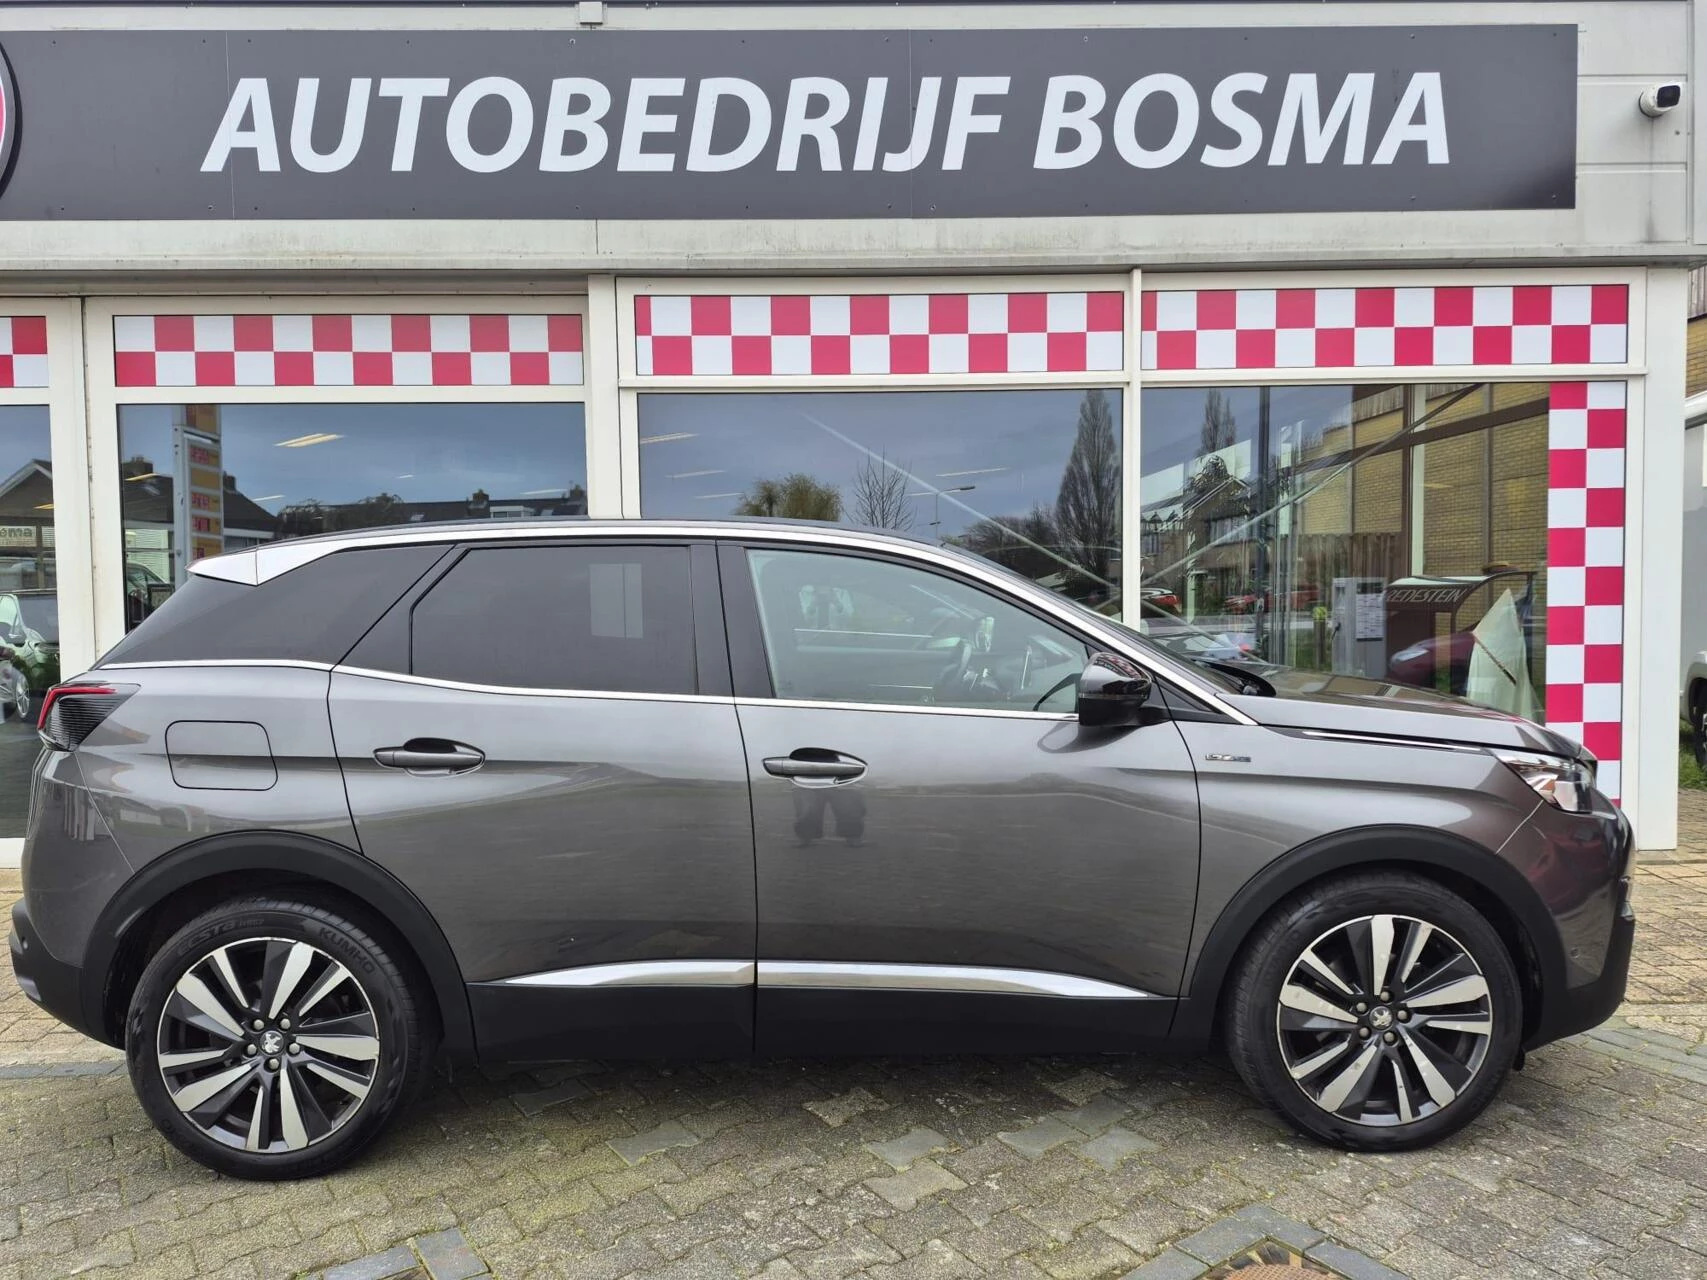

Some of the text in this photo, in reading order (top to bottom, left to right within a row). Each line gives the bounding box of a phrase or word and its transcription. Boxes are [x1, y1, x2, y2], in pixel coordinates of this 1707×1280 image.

[200, 72, 1450, 173] AUTOBEDRIJF BOSMA
[1385, 588, 1466, 602] REDESTEIN
